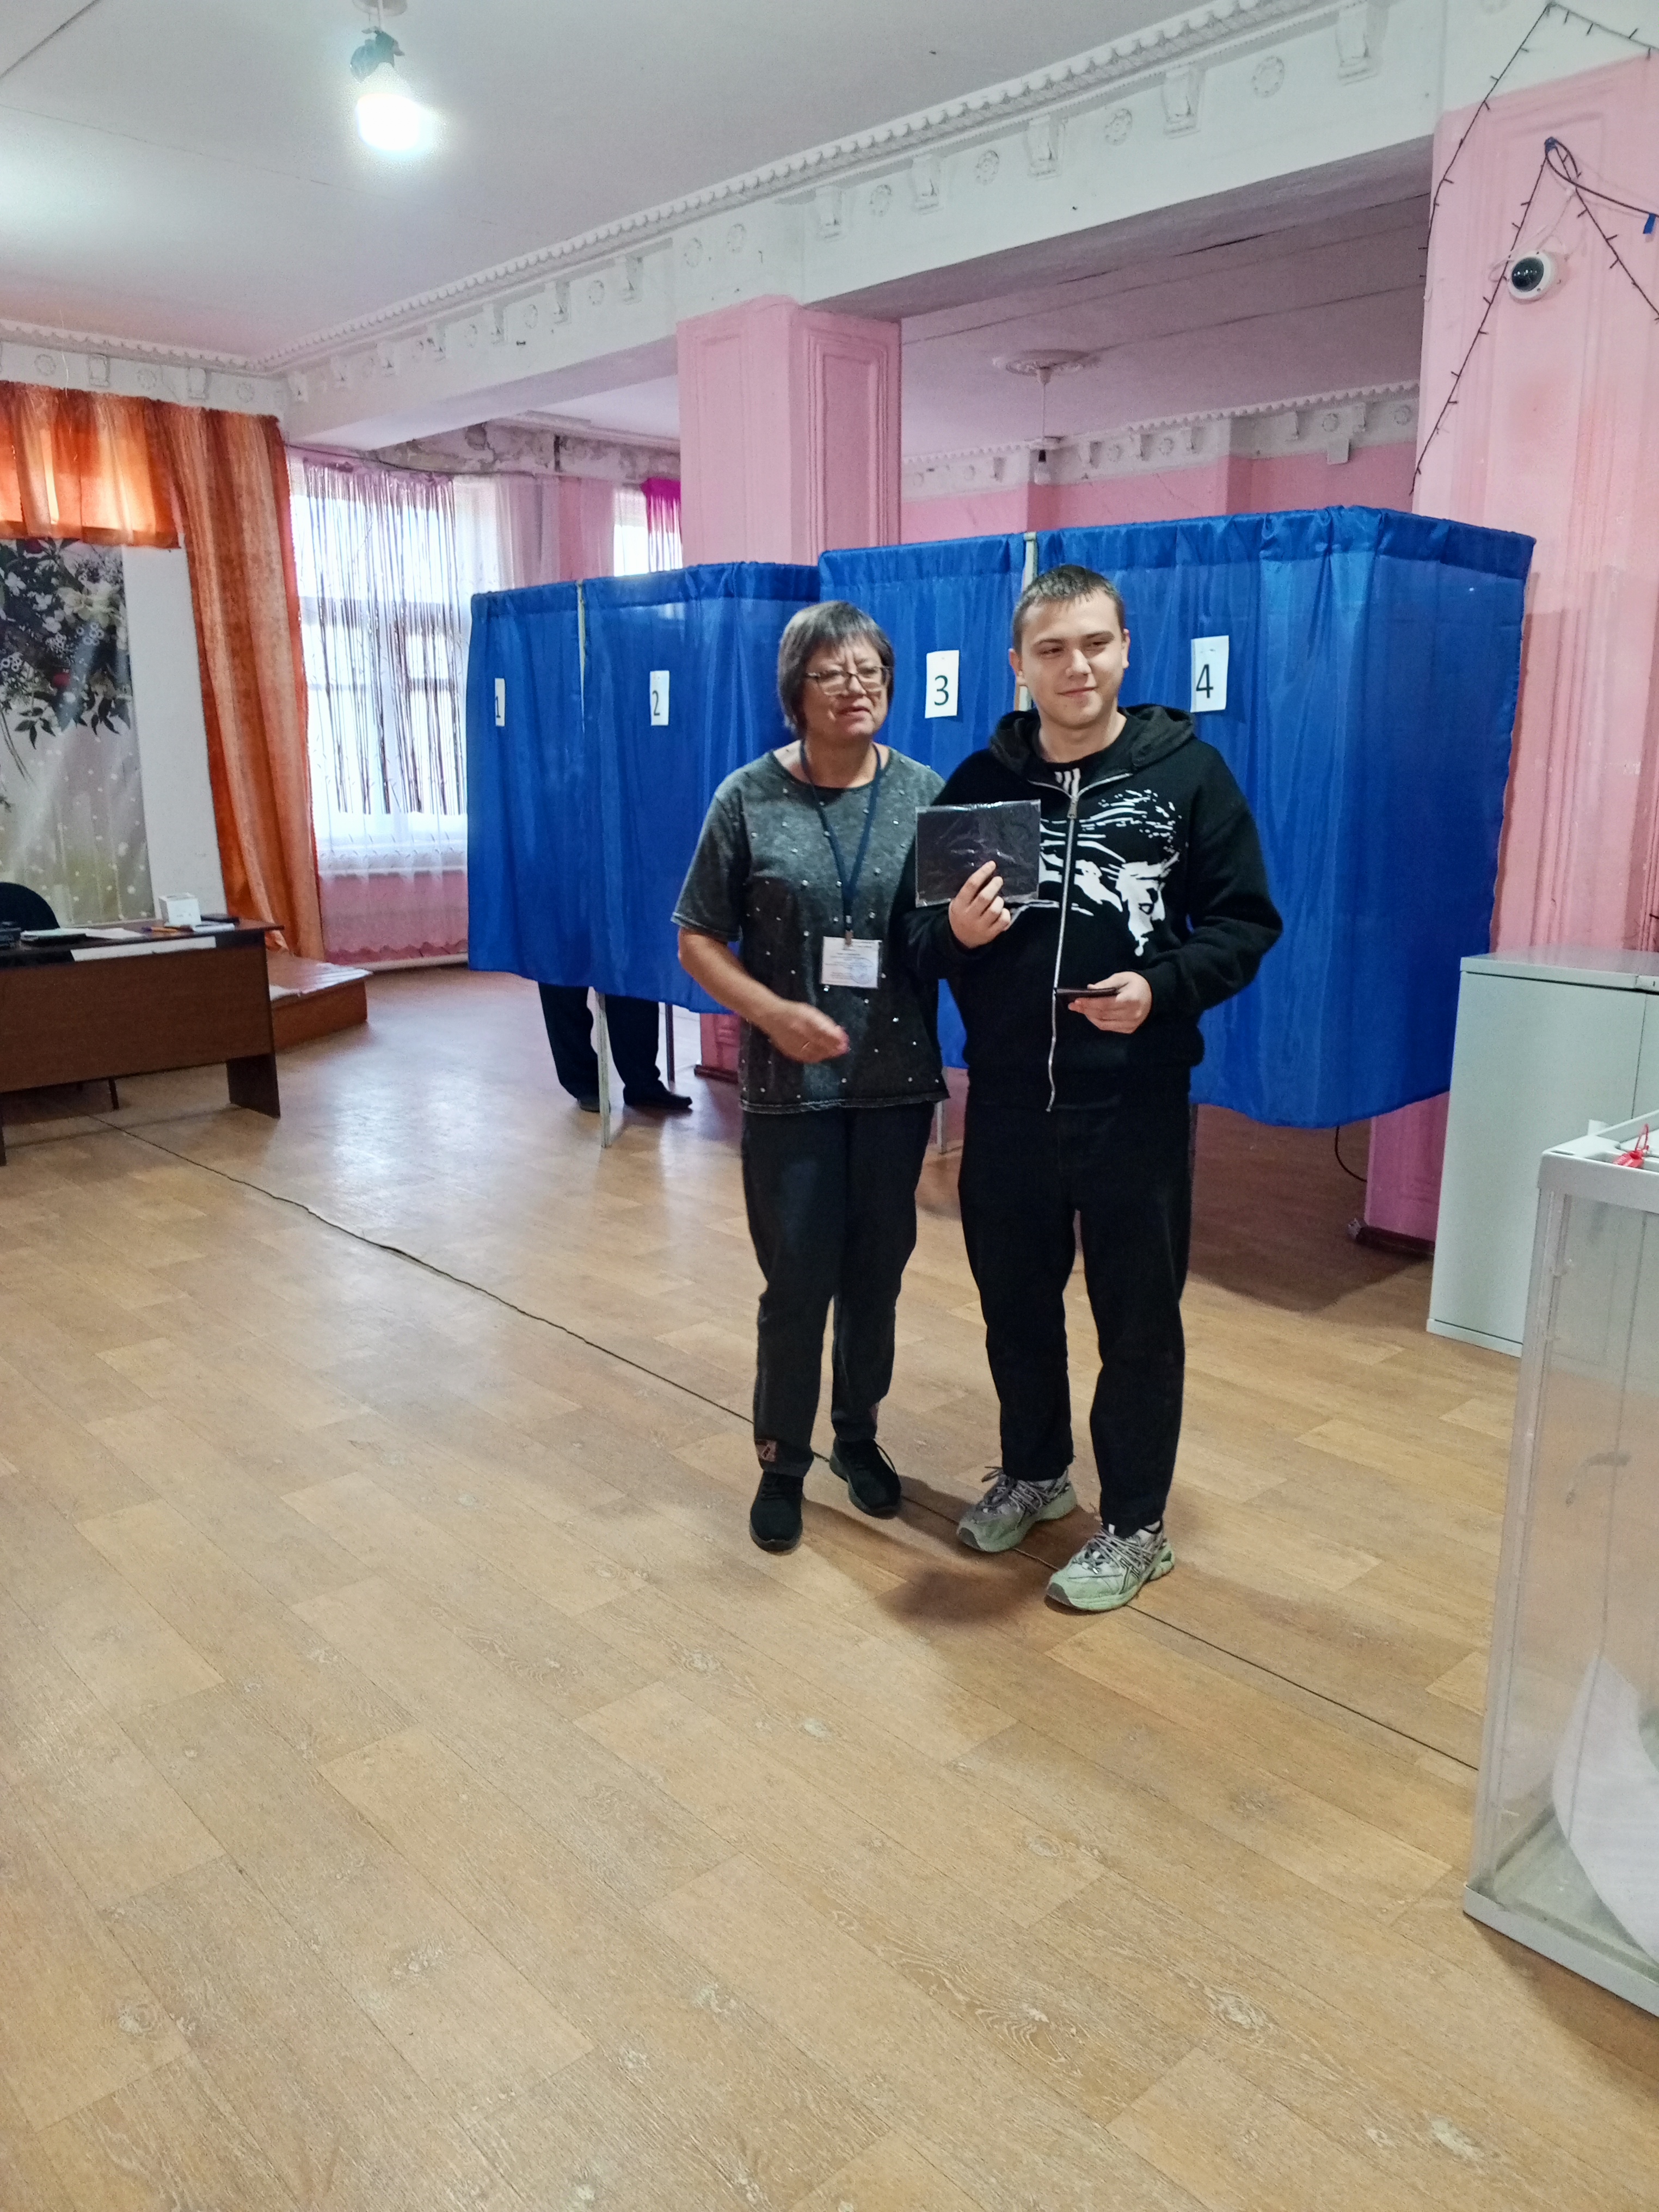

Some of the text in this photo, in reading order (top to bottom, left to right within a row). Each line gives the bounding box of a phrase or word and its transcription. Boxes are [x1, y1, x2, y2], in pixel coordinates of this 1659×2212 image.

[934, 675, 949, 706] 3
[1196, 664, 1214, 698] 4
[495, 696, 501, 718] 1
[652, 690, 660, 716] 2
